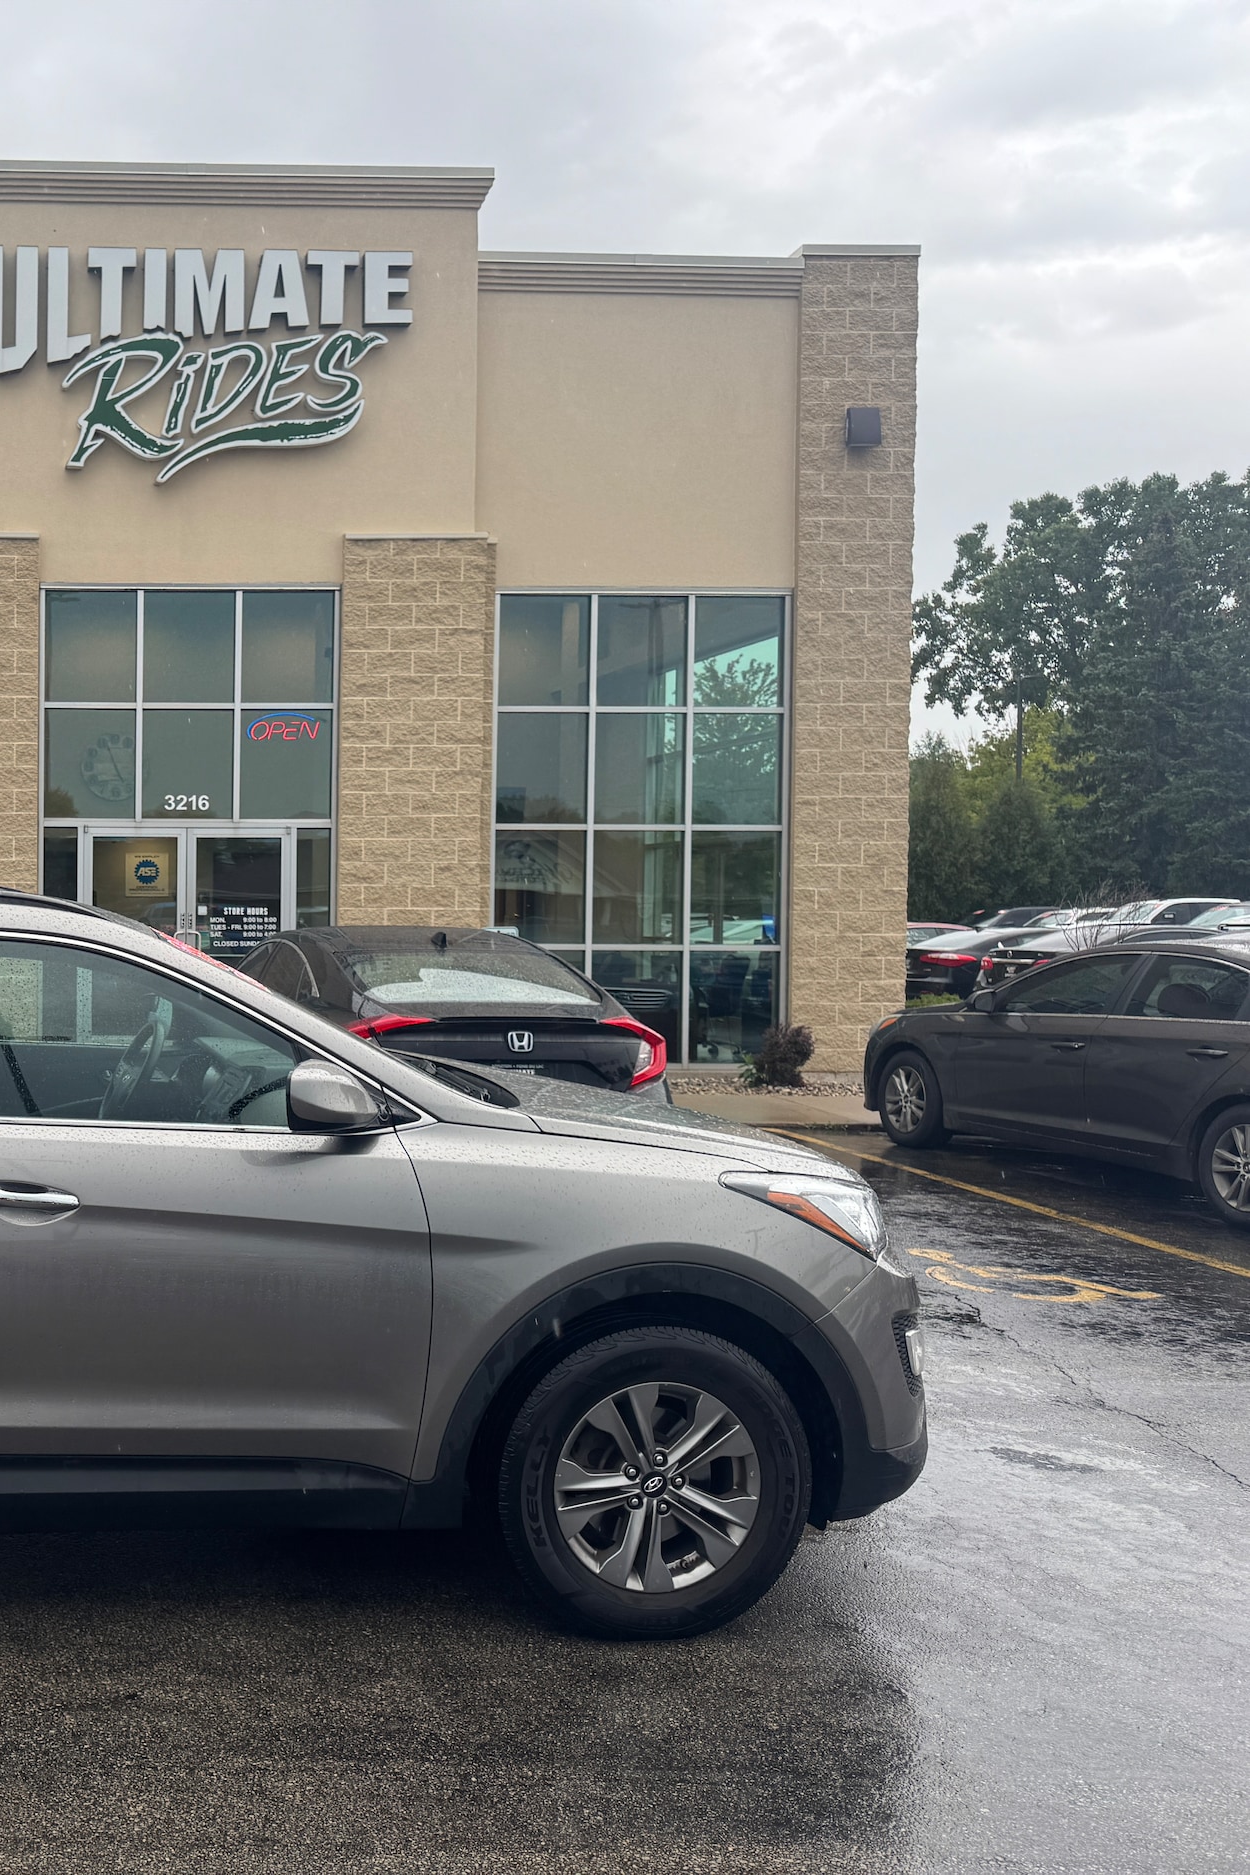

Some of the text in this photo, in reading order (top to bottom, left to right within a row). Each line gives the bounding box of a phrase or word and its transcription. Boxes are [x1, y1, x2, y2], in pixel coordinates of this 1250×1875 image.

[62, 330, 388, 469] RIDES
[250, 721, 320, 741] OPEN
[163, 794, 210, 811] 3216
[137, 867, 157, 877] ASE
[223, 907, 269, 916] STORE HOURS
[526, 1430, 550, 1548] KELLY
